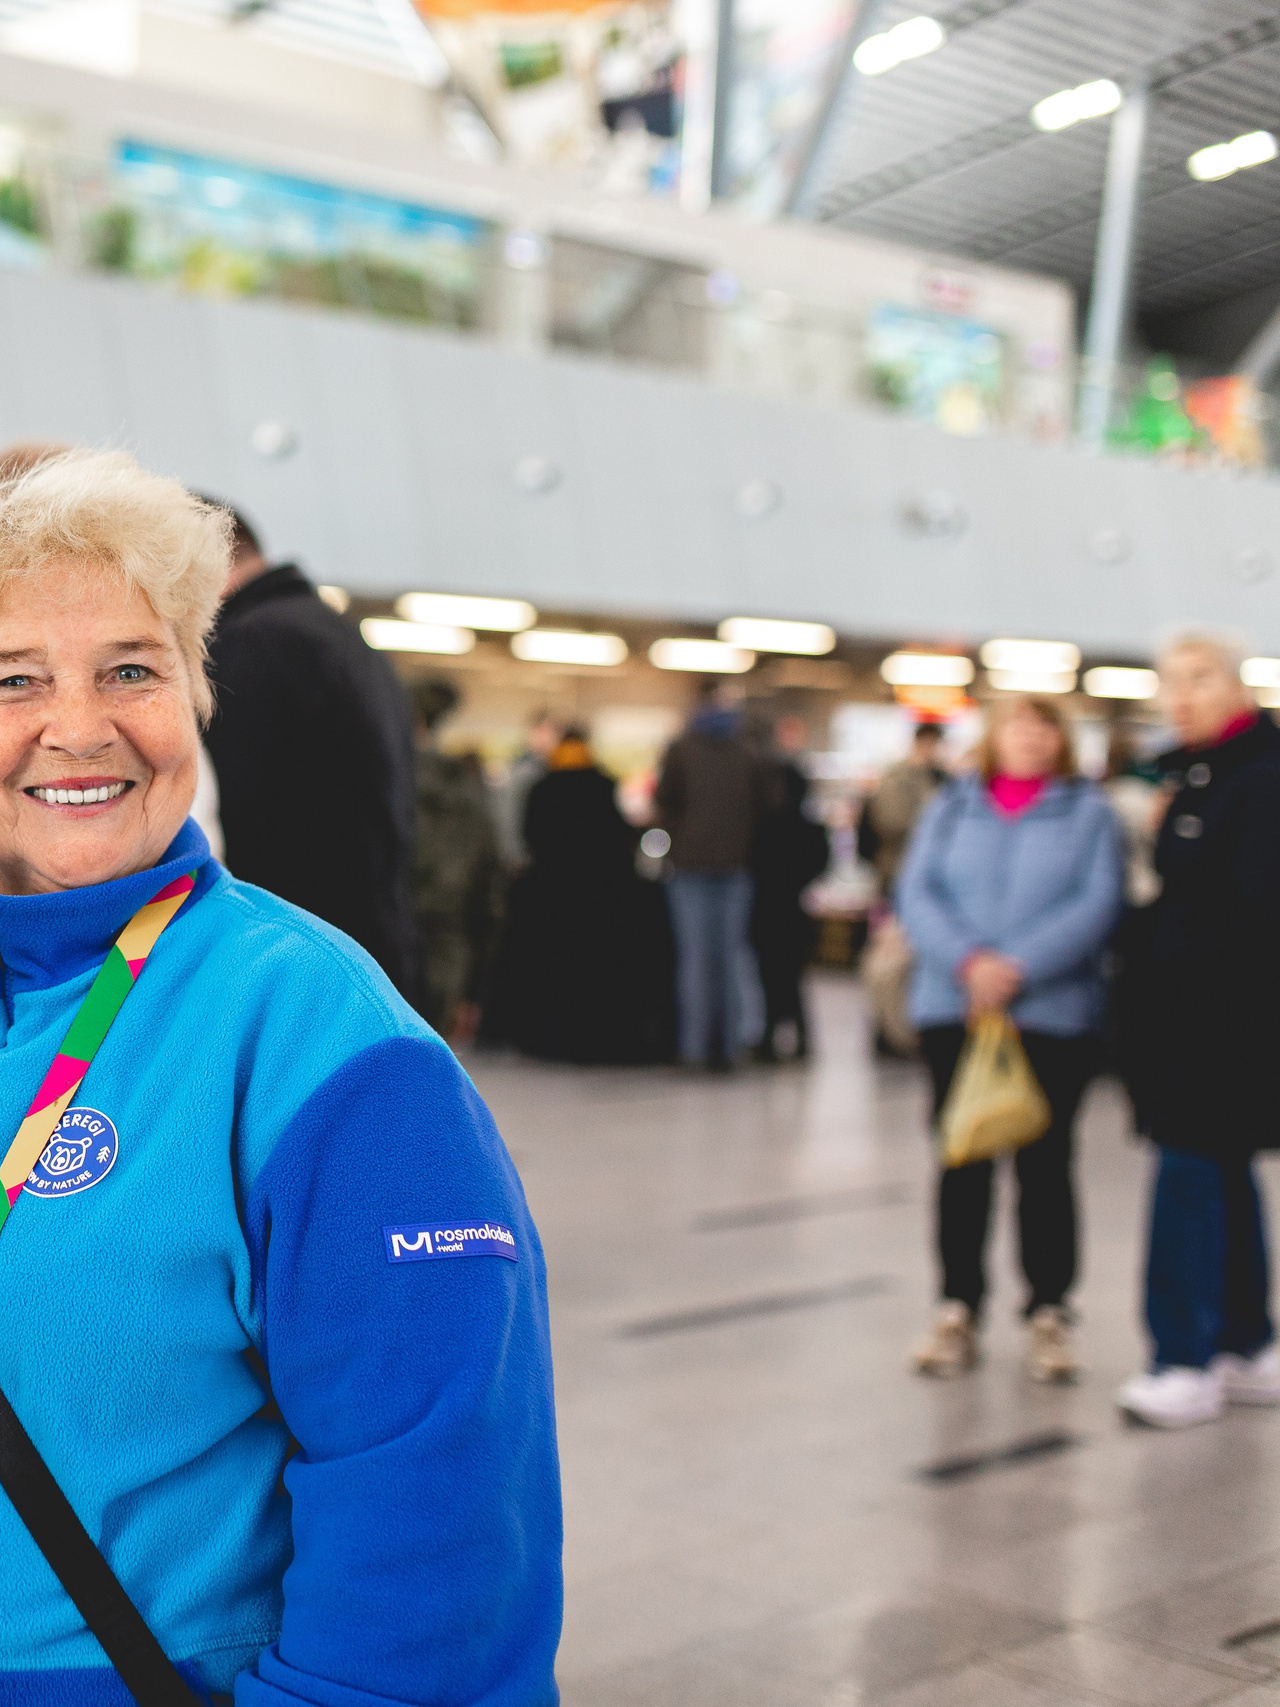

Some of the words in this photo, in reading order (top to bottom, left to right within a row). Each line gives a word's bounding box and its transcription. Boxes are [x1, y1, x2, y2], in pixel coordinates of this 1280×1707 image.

[28, 1169, 40, 1184] RN
[37, 1179, 51, 1190] BY
[52, 1170, 93, 1190] NATURE
[434, 1223, 516, 1246] rosmolodezh
